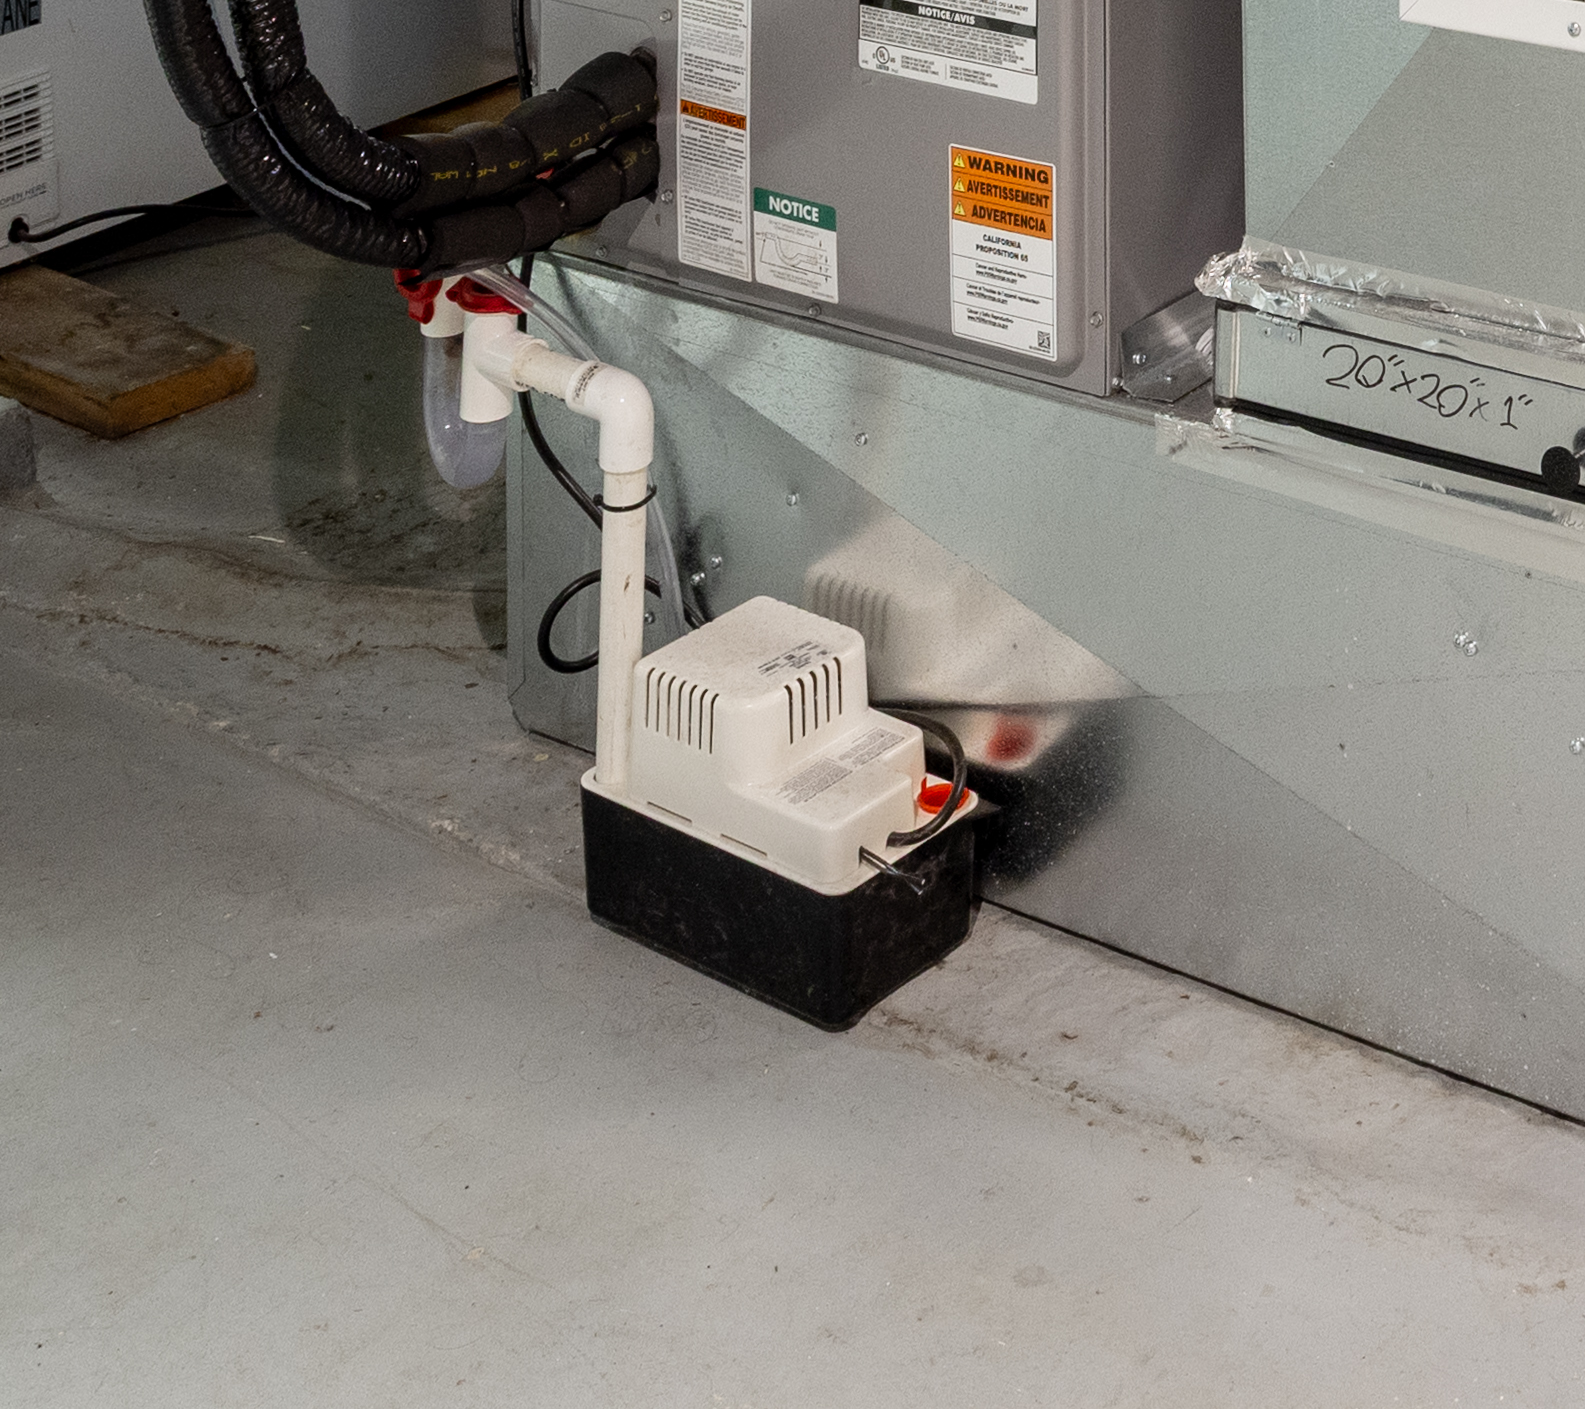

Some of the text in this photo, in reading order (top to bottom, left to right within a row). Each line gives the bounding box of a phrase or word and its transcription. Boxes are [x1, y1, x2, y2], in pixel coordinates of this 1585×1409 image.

[919, 6, 975, 26] NOTICE/AVIS
[688, 104, 745, 128] AVERTISSEMENT
[968, 155, 1049, 185] WARNING
[0, 182, 48, 207] OPEN HERE
[967, 179, 1049, 209] AVERTISSEMENT
[769, 195, 819, 223] NOTICE
[972, 204, 1046, 233] ADVERTENCIA
[975, 244, 1019, 260] PROPOSITION
[983, 234, 1021, 249] CALIFORNIA
